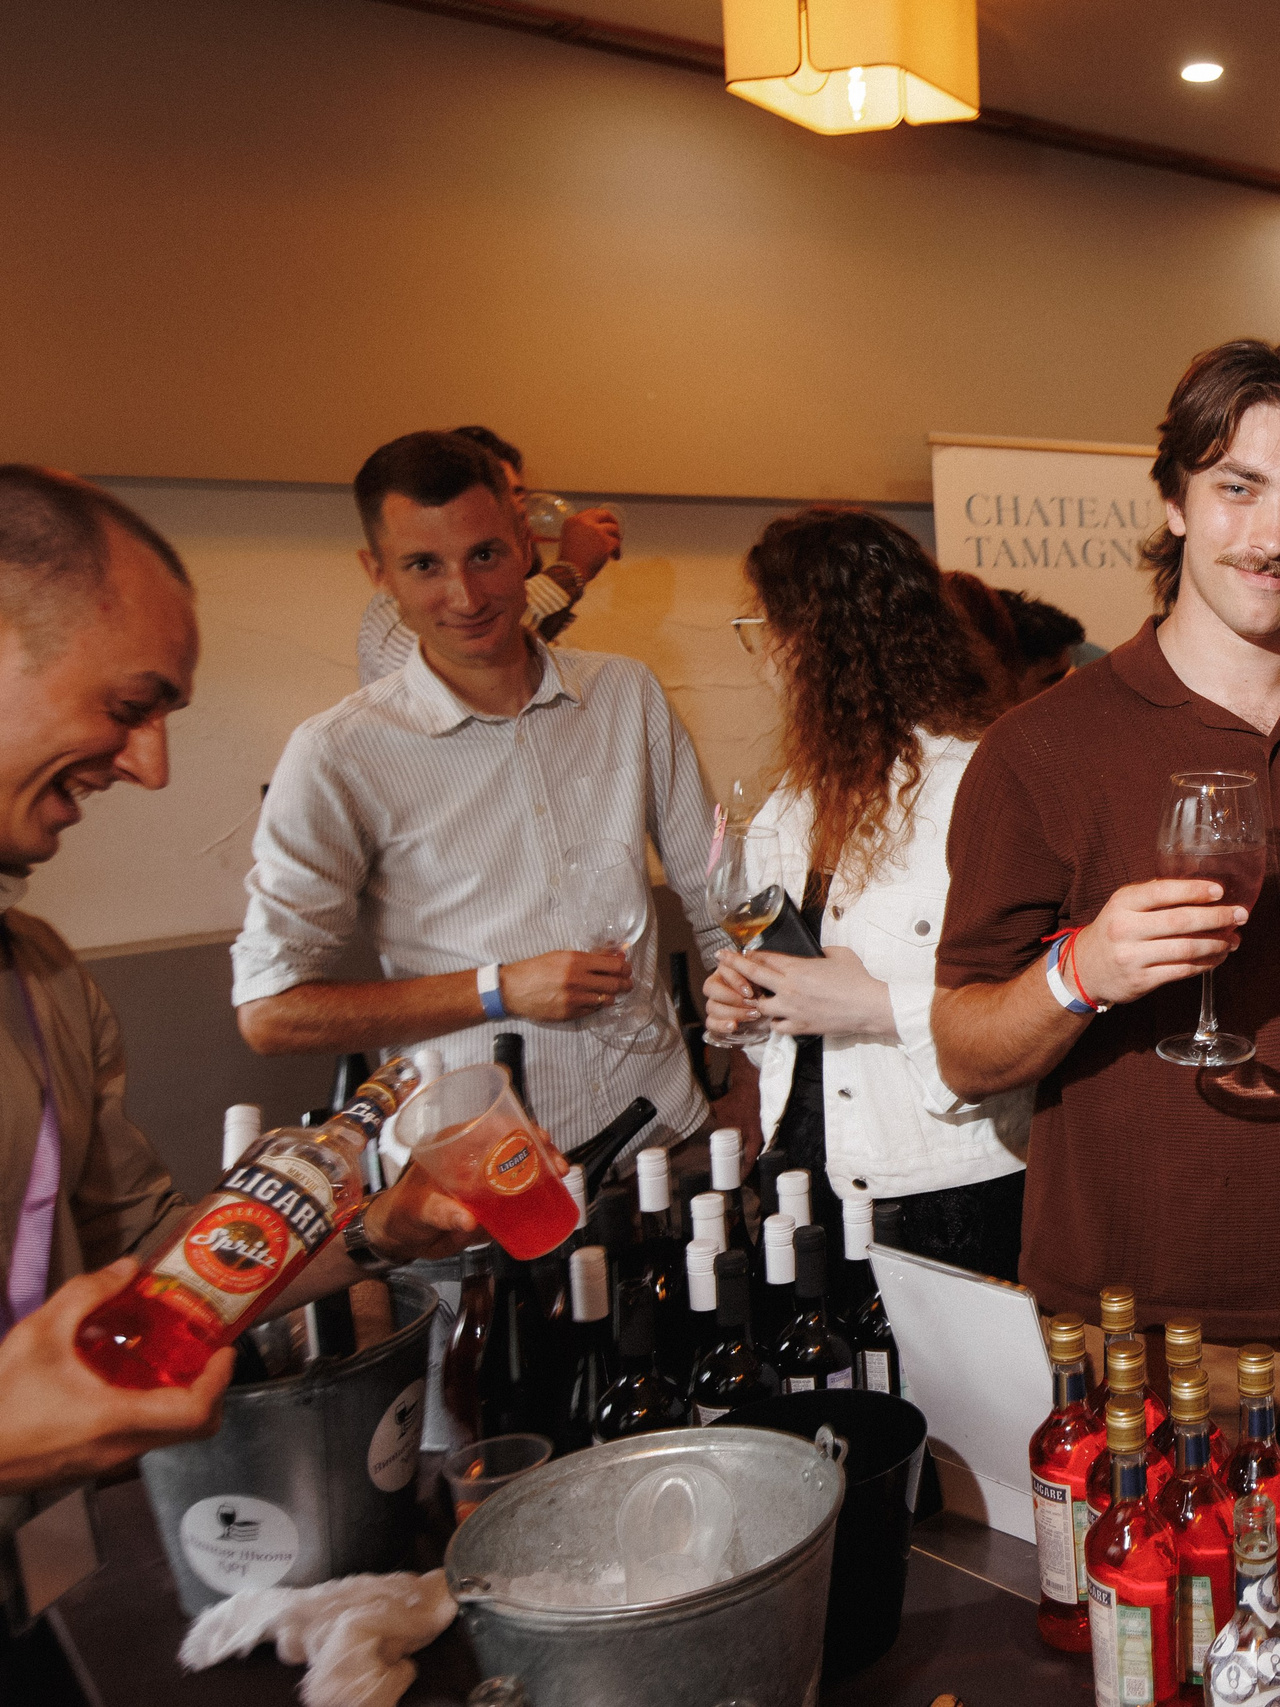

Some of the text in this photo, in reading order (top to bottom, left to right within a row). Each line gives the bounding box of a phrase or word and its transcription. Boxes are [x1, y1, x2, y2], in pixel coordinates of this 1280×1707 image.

[965, 494, 1150, 529] CHATEAU
[964, 536, 1136, 568] TAMAGN
[499, 1149, 529, 1172] LIGARE
[225, 1168, 327, 1245] LIGARE
[214, 1206, 285, 1243] APERITIVO
[189, 1227, 278, 1270] Spritz
[1033, 1480, 1063, 1501] LIGARE
